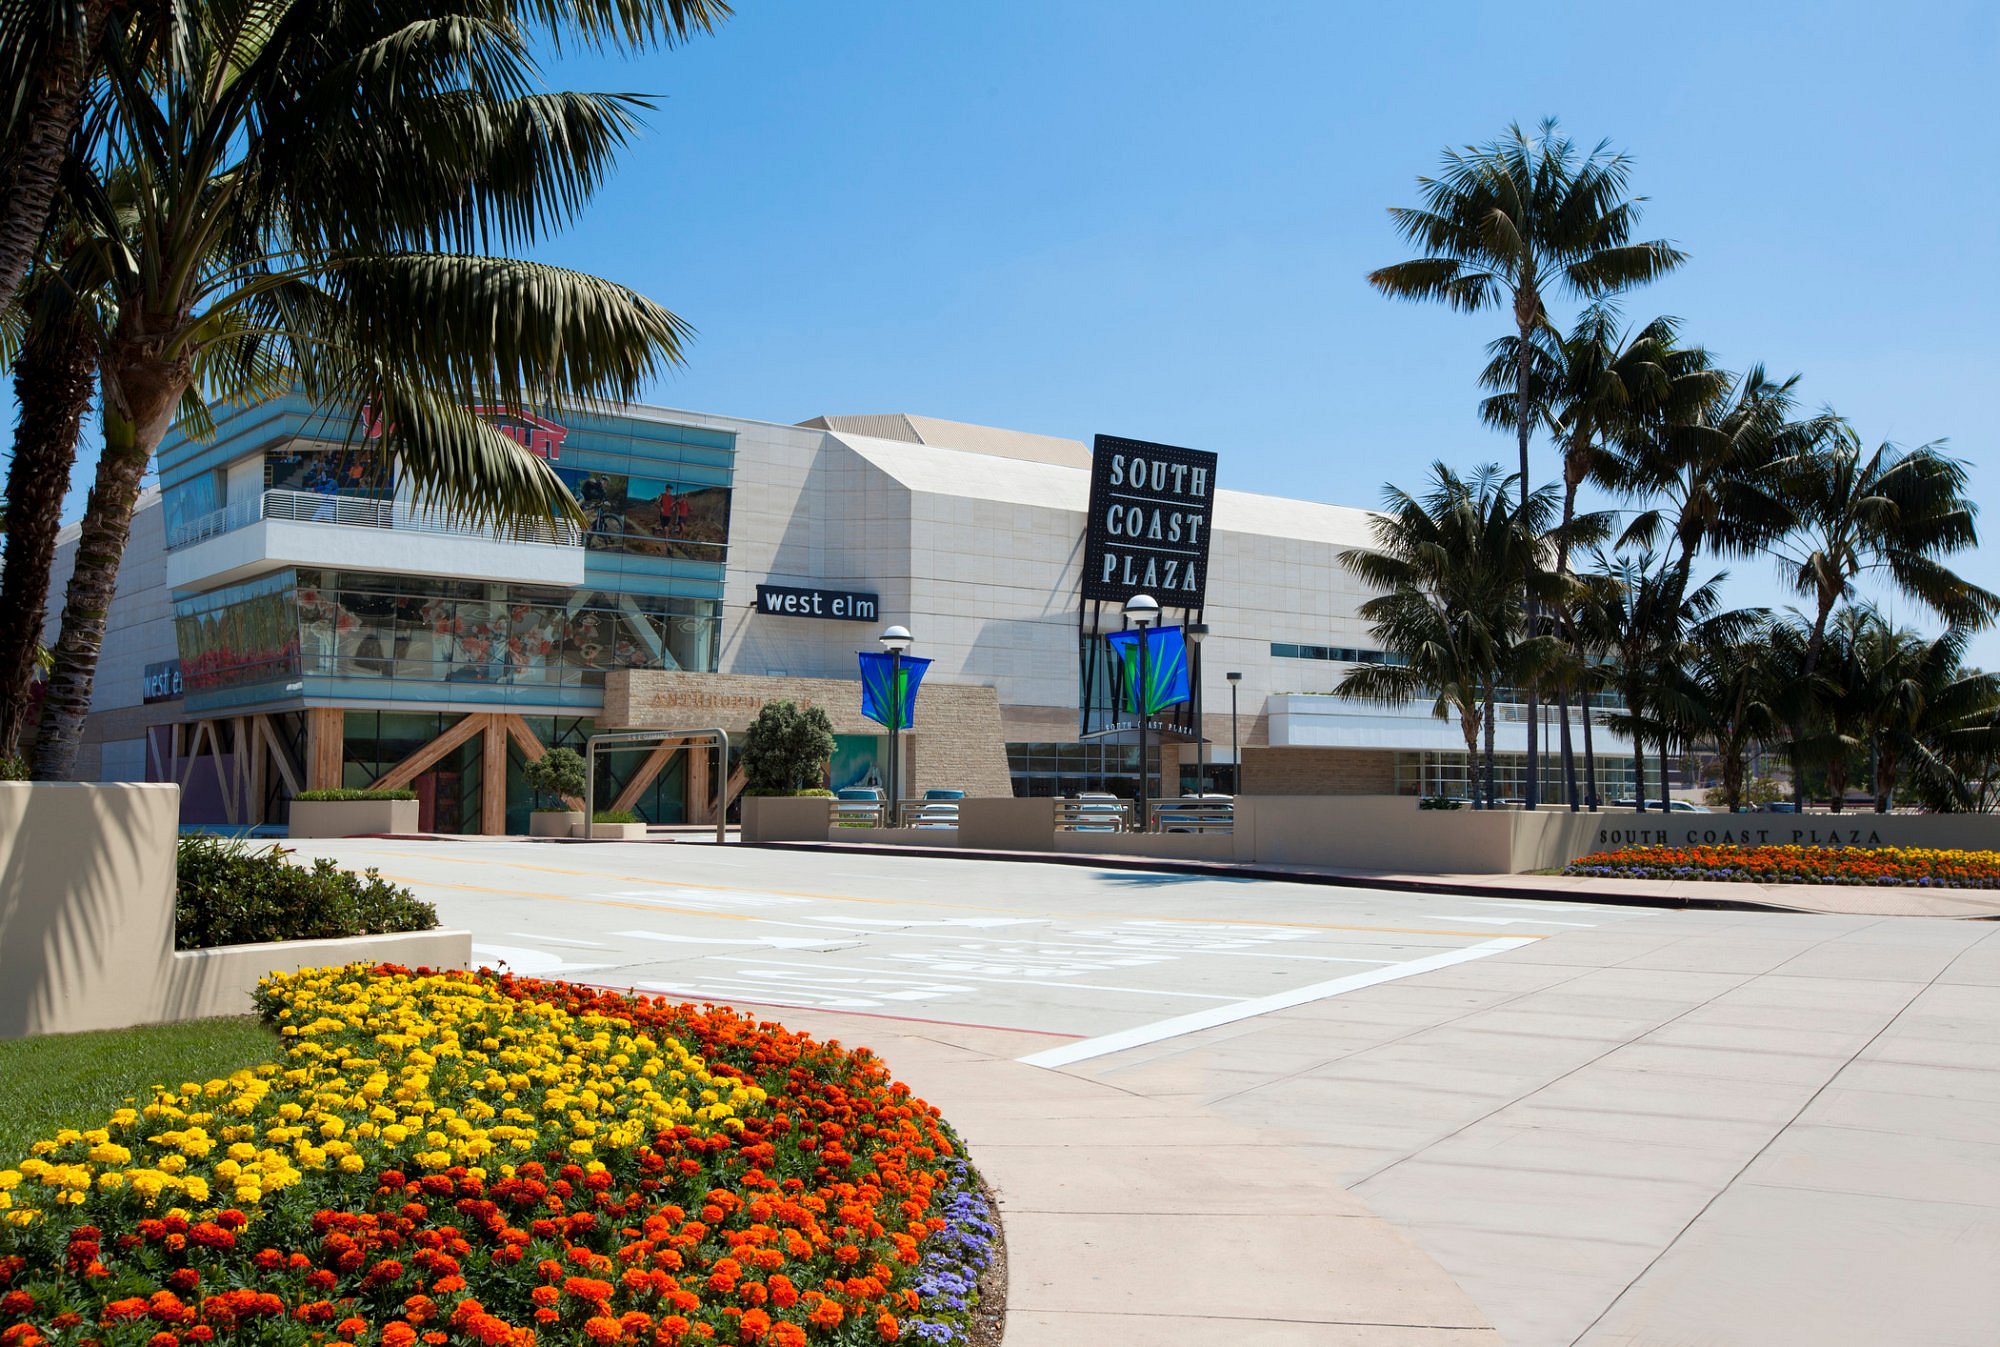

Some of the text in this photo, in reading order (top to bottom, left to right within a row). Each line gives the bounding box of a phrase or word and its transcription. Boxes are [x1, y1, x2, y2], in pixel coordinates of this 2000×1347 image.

[1110, 454, 1207, 497] SOUTH
[1106, 504, 1203, 544] COAST
[1101, 553, 1197, 591] PLAZA
[765, 592, 874, 618] west elm
[144, 667, 169, 697] west
[1168, 723, 1193, 736] PLAZA
[1600, 830, 1882, 844] SOUTH COAST PLAZA
